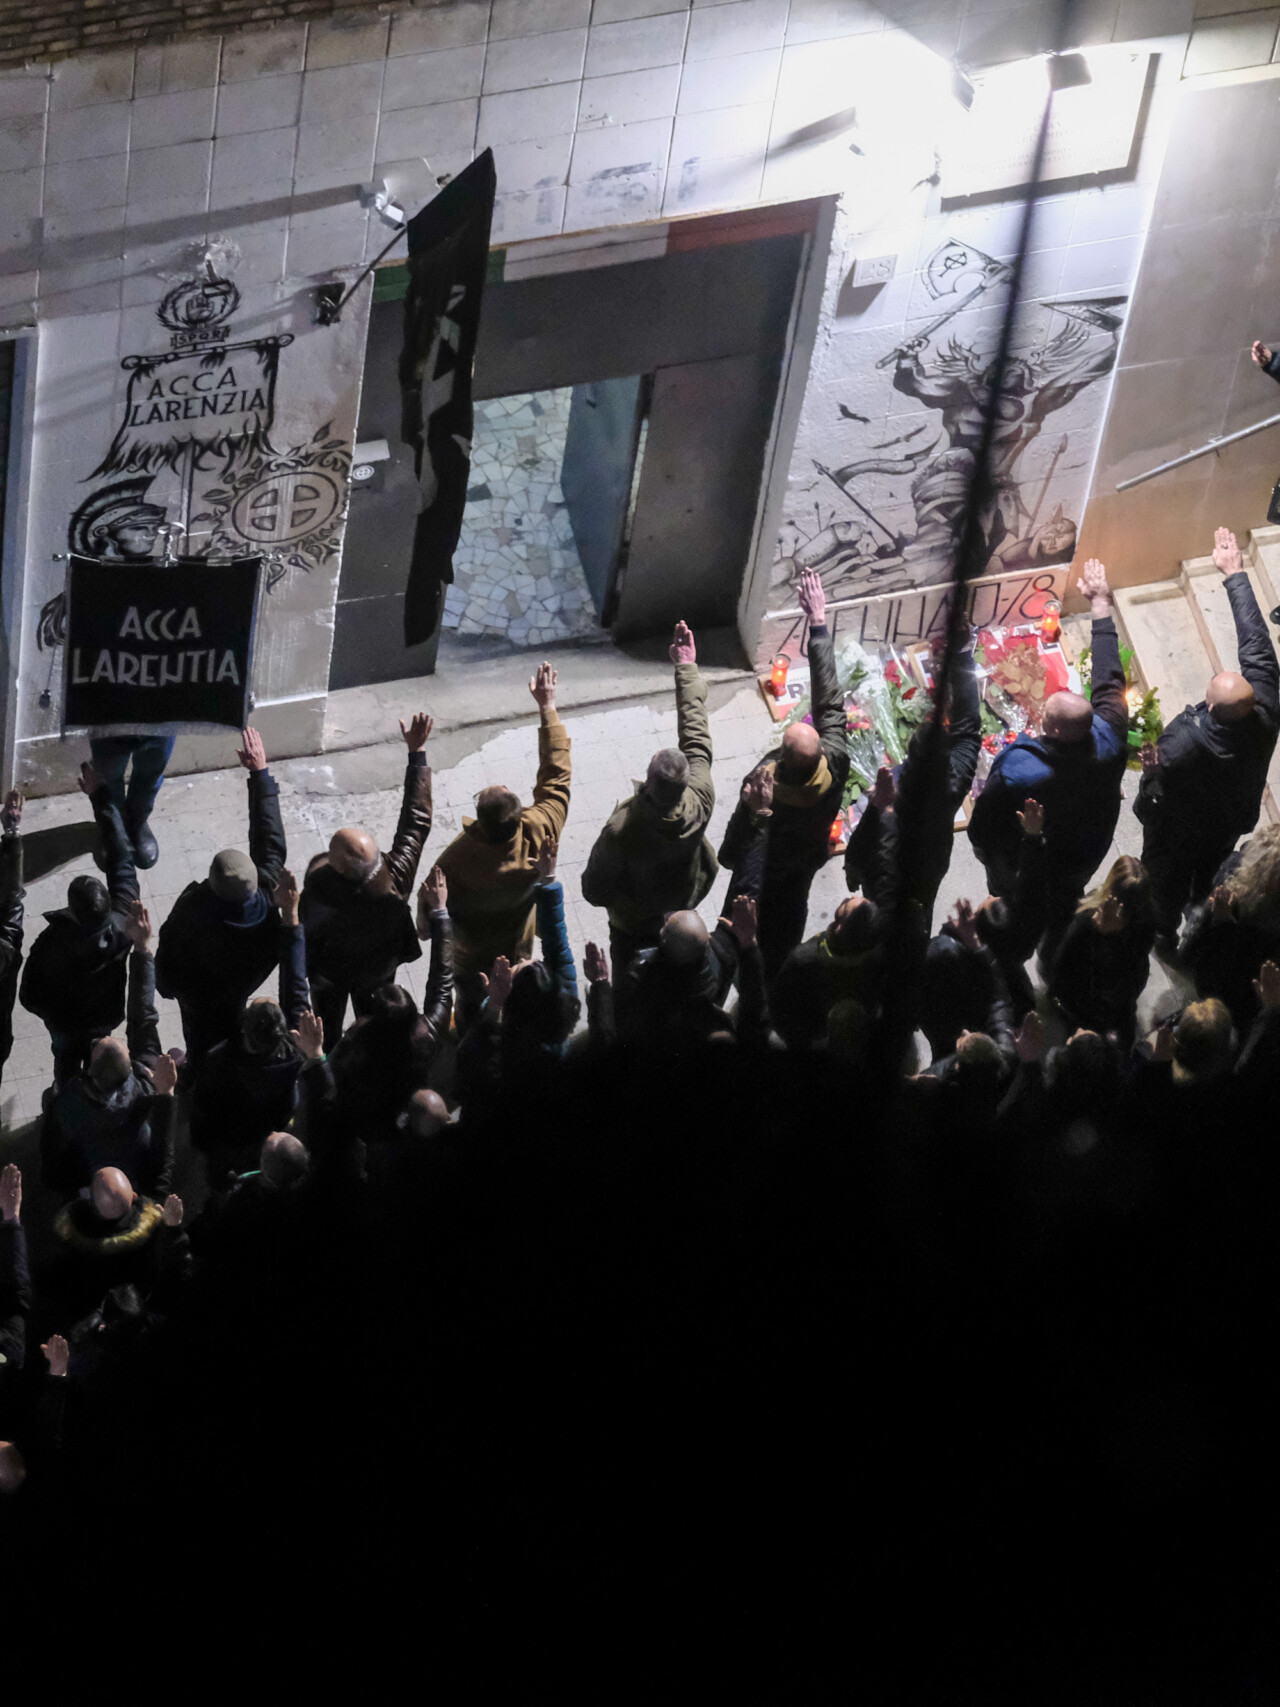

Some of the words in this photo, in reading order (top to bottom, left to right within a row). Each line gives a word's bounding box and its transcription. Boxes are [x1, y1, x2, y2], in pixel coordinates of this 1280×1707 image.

[147, 367, 237, 400] ACCA
[128, 388, 267, 427] LARENZIA
[120, 606, 202, 641] ACCA
[72, 648, 240, 686] LARENTIA
